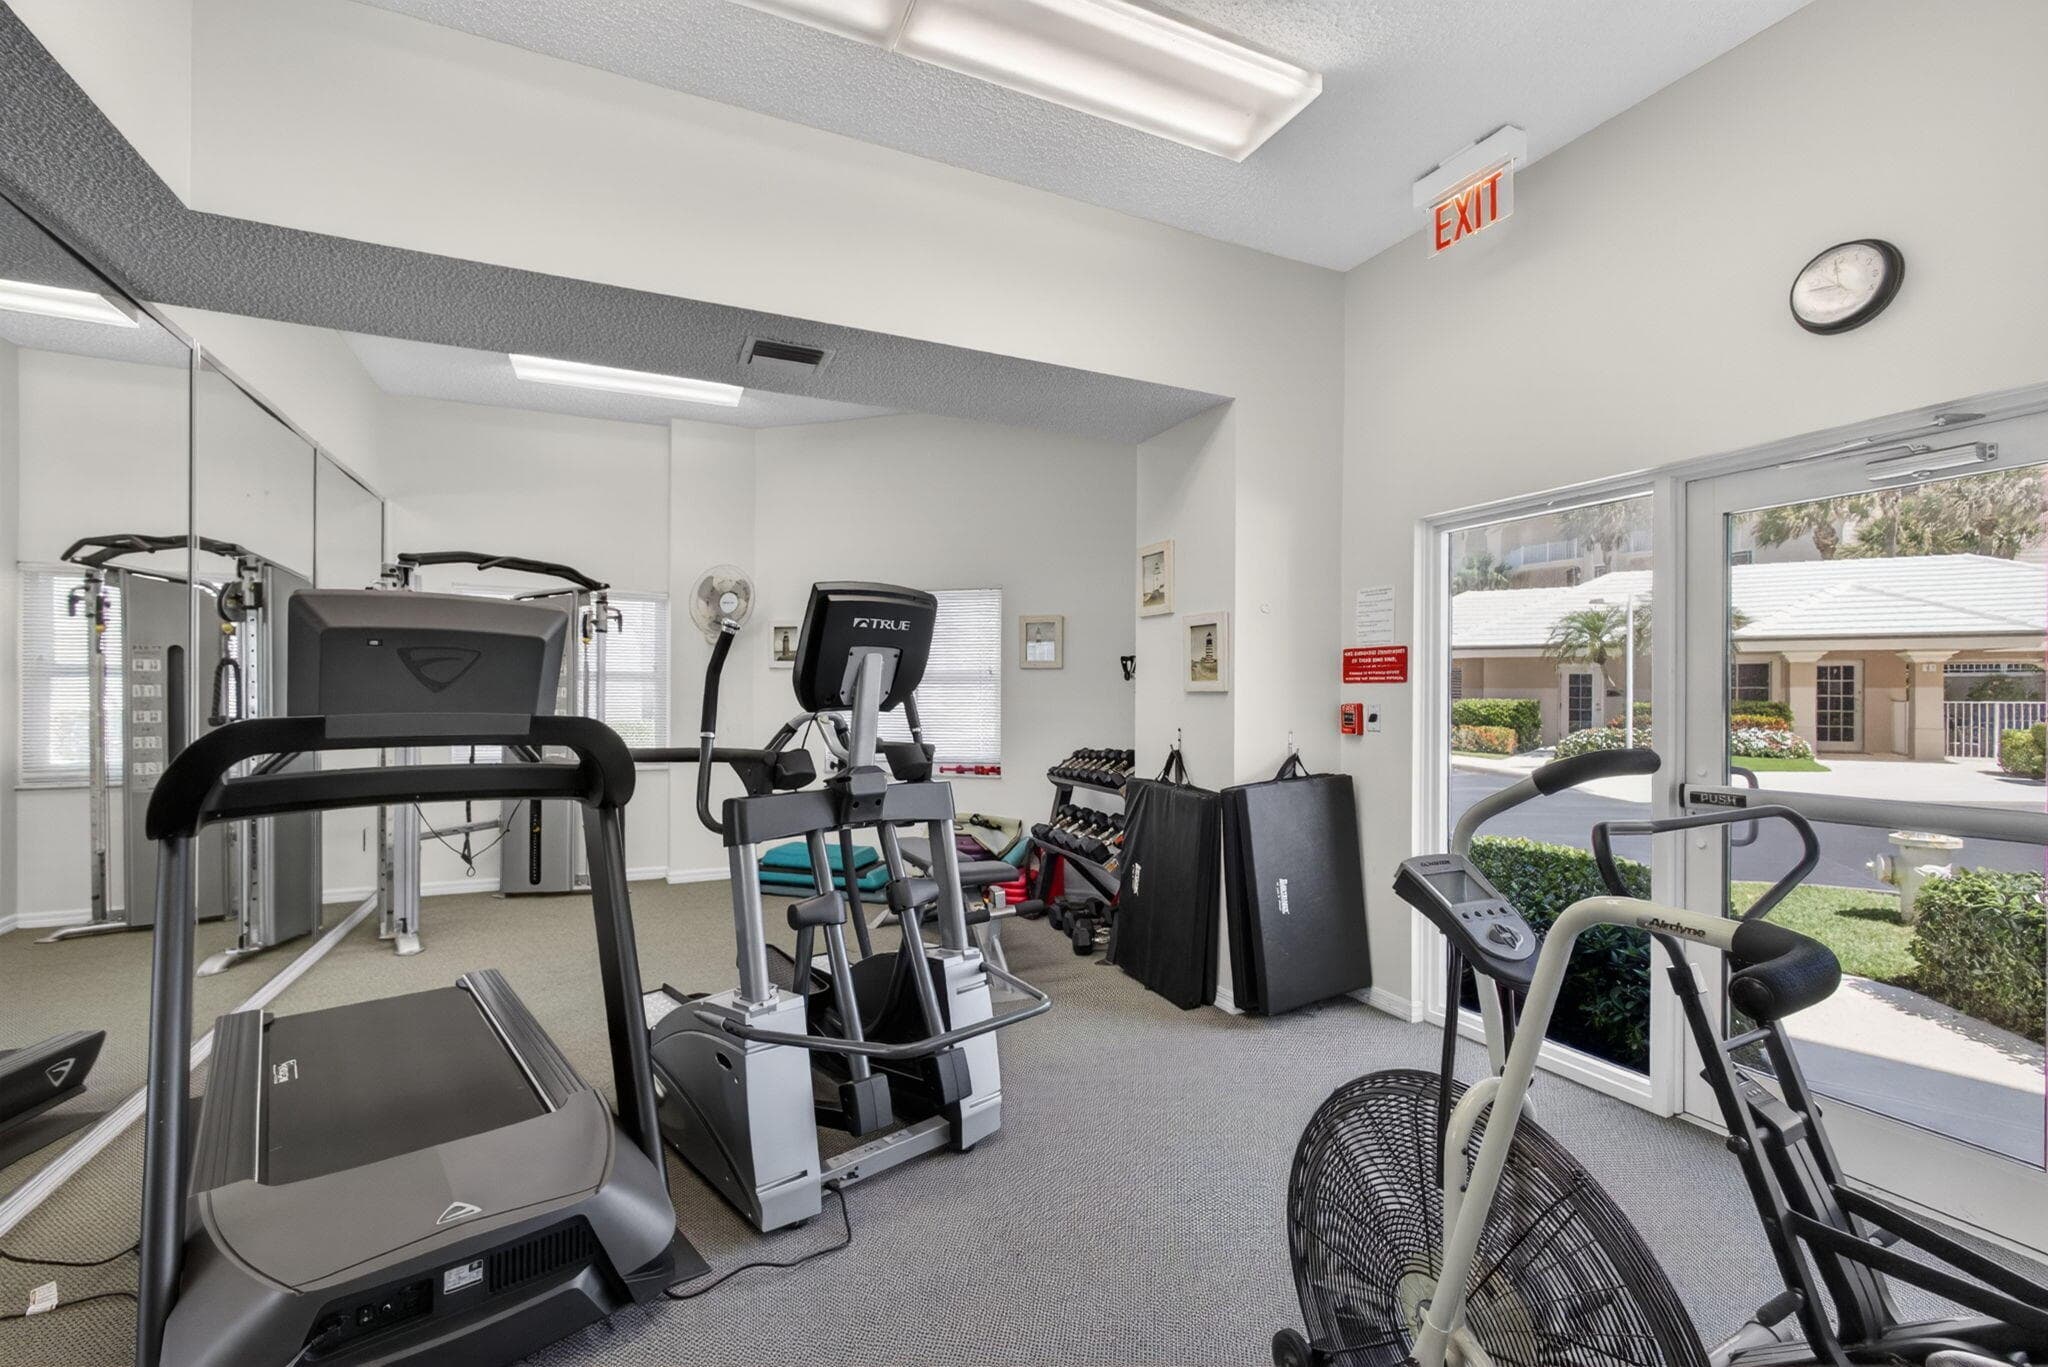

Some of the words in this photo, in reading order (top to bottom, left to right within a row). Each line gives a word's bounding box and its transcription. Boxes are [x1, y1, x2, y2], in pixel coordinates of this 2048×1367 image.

[1435, 170, 1503, 251] EXIT
[870, 618, 911, 631] TRUE
[1700, 793, 1737, 806] PUSH
